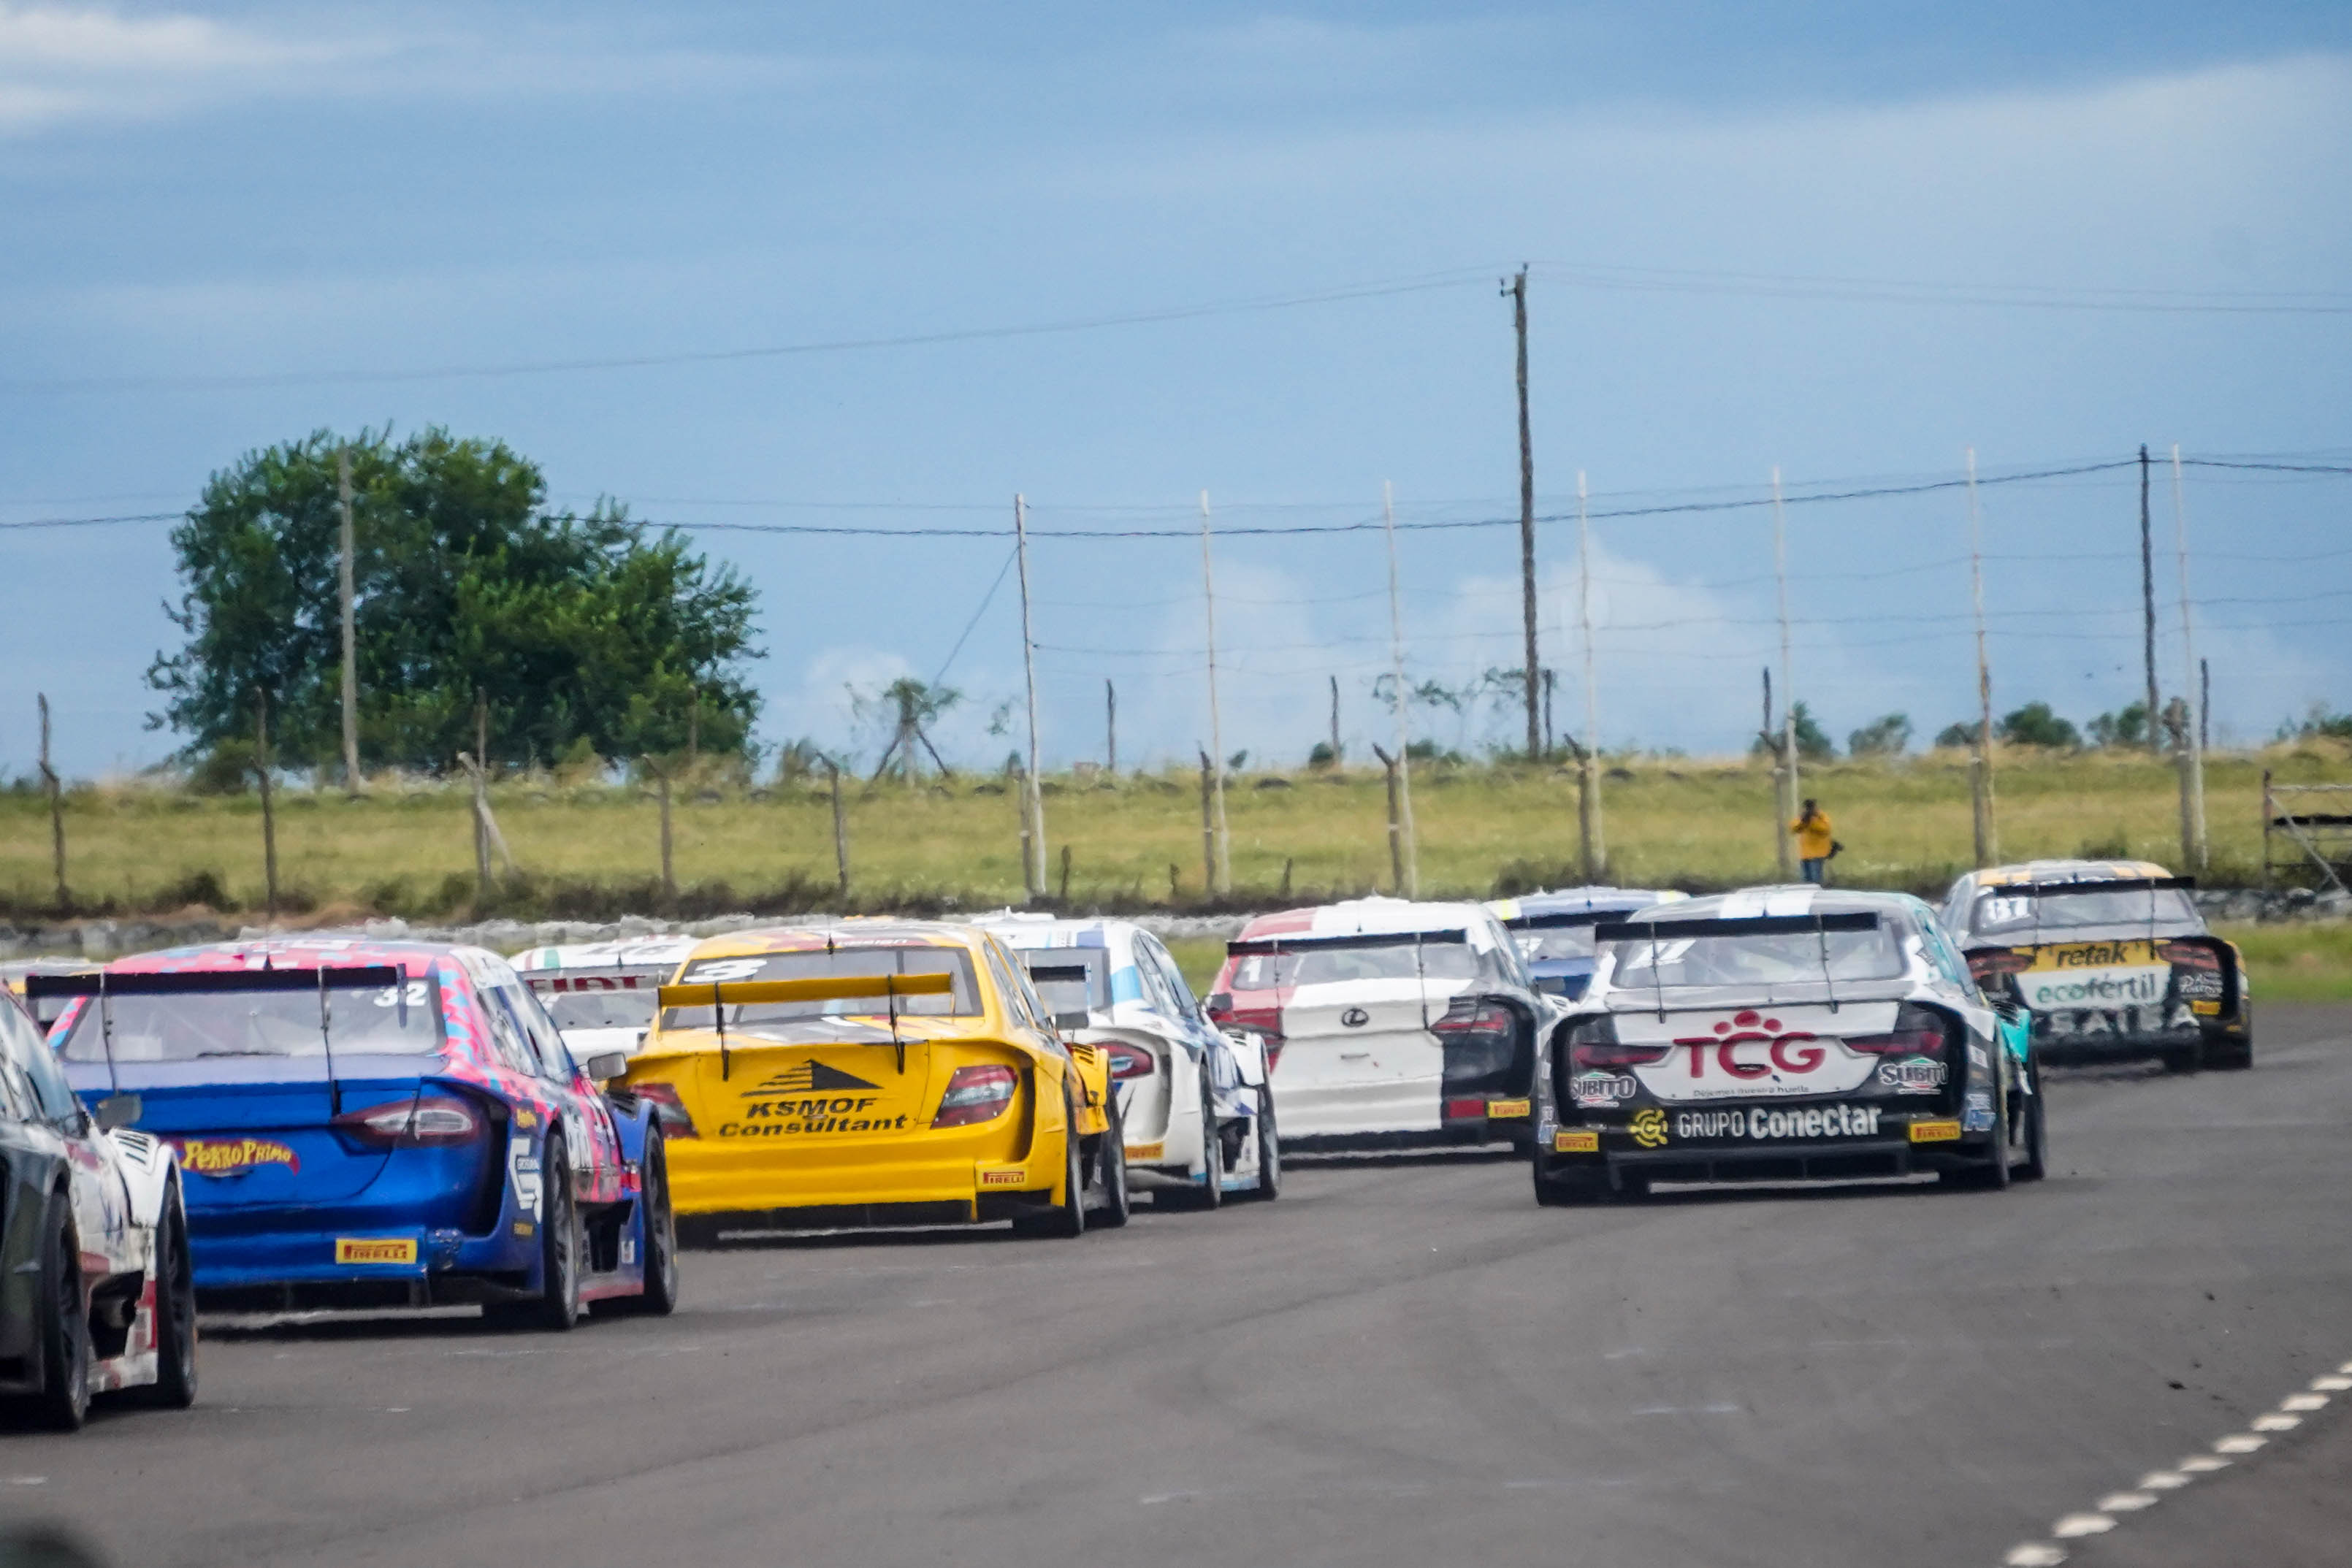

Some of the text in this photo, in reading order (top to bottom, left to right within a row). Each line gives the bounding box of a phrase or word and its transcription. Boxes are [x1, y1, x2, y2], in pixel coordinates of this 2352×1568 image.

[2055, 942, 2126, 968] retak
[683, 958, 768, 983] 3
[1243, 955, 1262, 982] 1
[373, 982, 428, 1007] 32
[1672, 1030, 1826, 1081] TCG
[746, 1096, 878, 1120] KSMOF
[718, 1113, 909, 1138] Consultant
[1679, 1104, 1882, 1139] GRUPO Conectar
[983, 1171, 1025, 1184] PIRELLI
